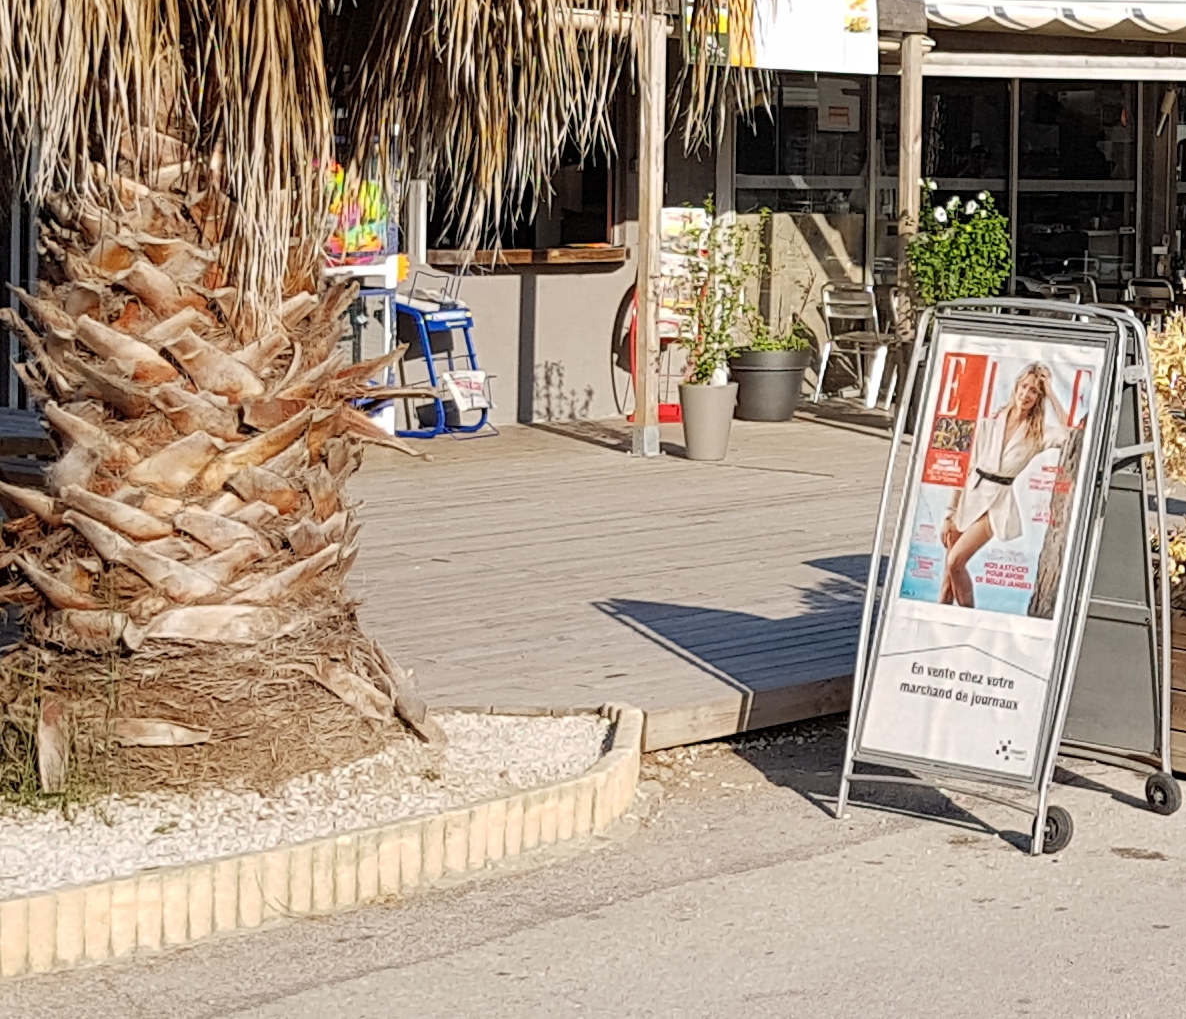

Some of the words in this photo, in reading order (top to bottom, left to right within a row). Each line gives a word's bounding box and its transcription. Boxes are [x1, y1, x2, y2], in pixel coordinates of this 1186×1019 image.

[911, 662, 924, 674] En
[927, 666, 956, 680] vente
[959, 671, 983, 685] chez
[986, 676, 1014, 689] votre
[900, 682, 953, 699] marchand
[955, 690, 968, 702] de
[970, 691, 1019, 710] journaux
